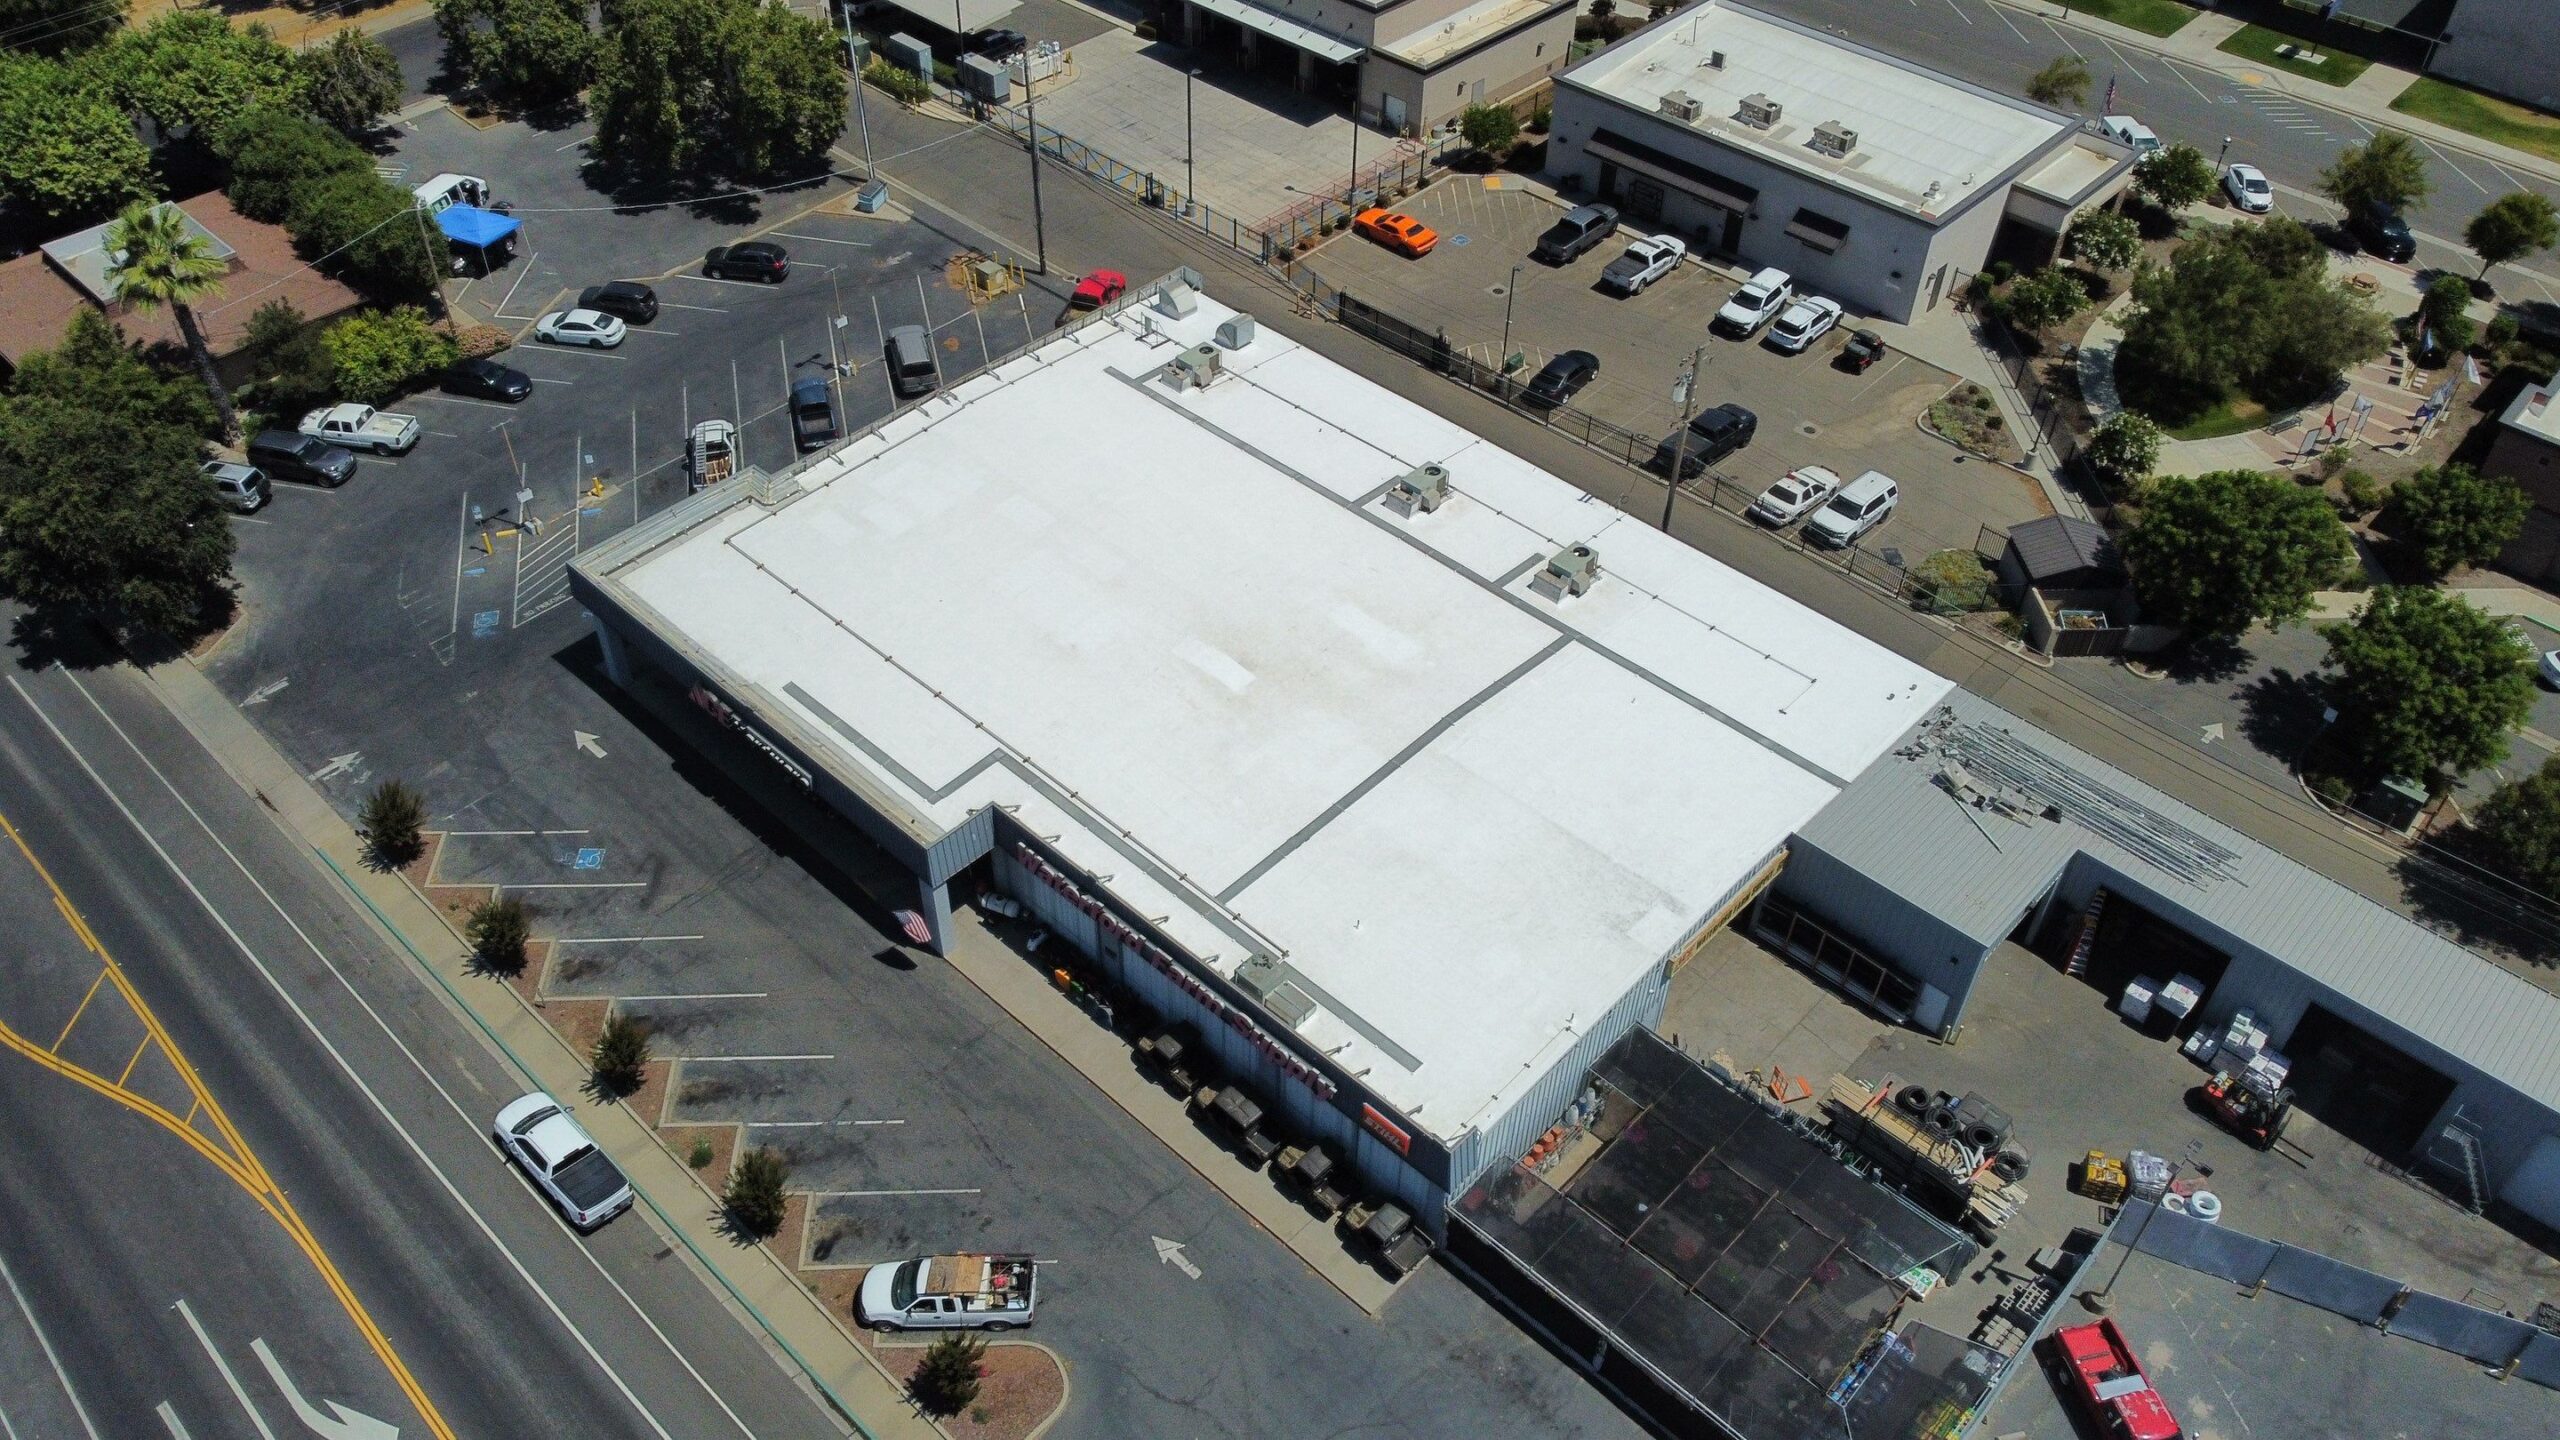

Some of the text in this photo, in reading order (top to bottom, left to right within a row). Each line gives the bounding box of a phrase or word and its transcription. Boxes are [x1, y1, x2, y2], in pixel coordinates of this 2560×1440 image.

[1016, 841, 1338, 1101] Waterford Farm Supply
[1364, 1115, 1404, 1151] STIHL
